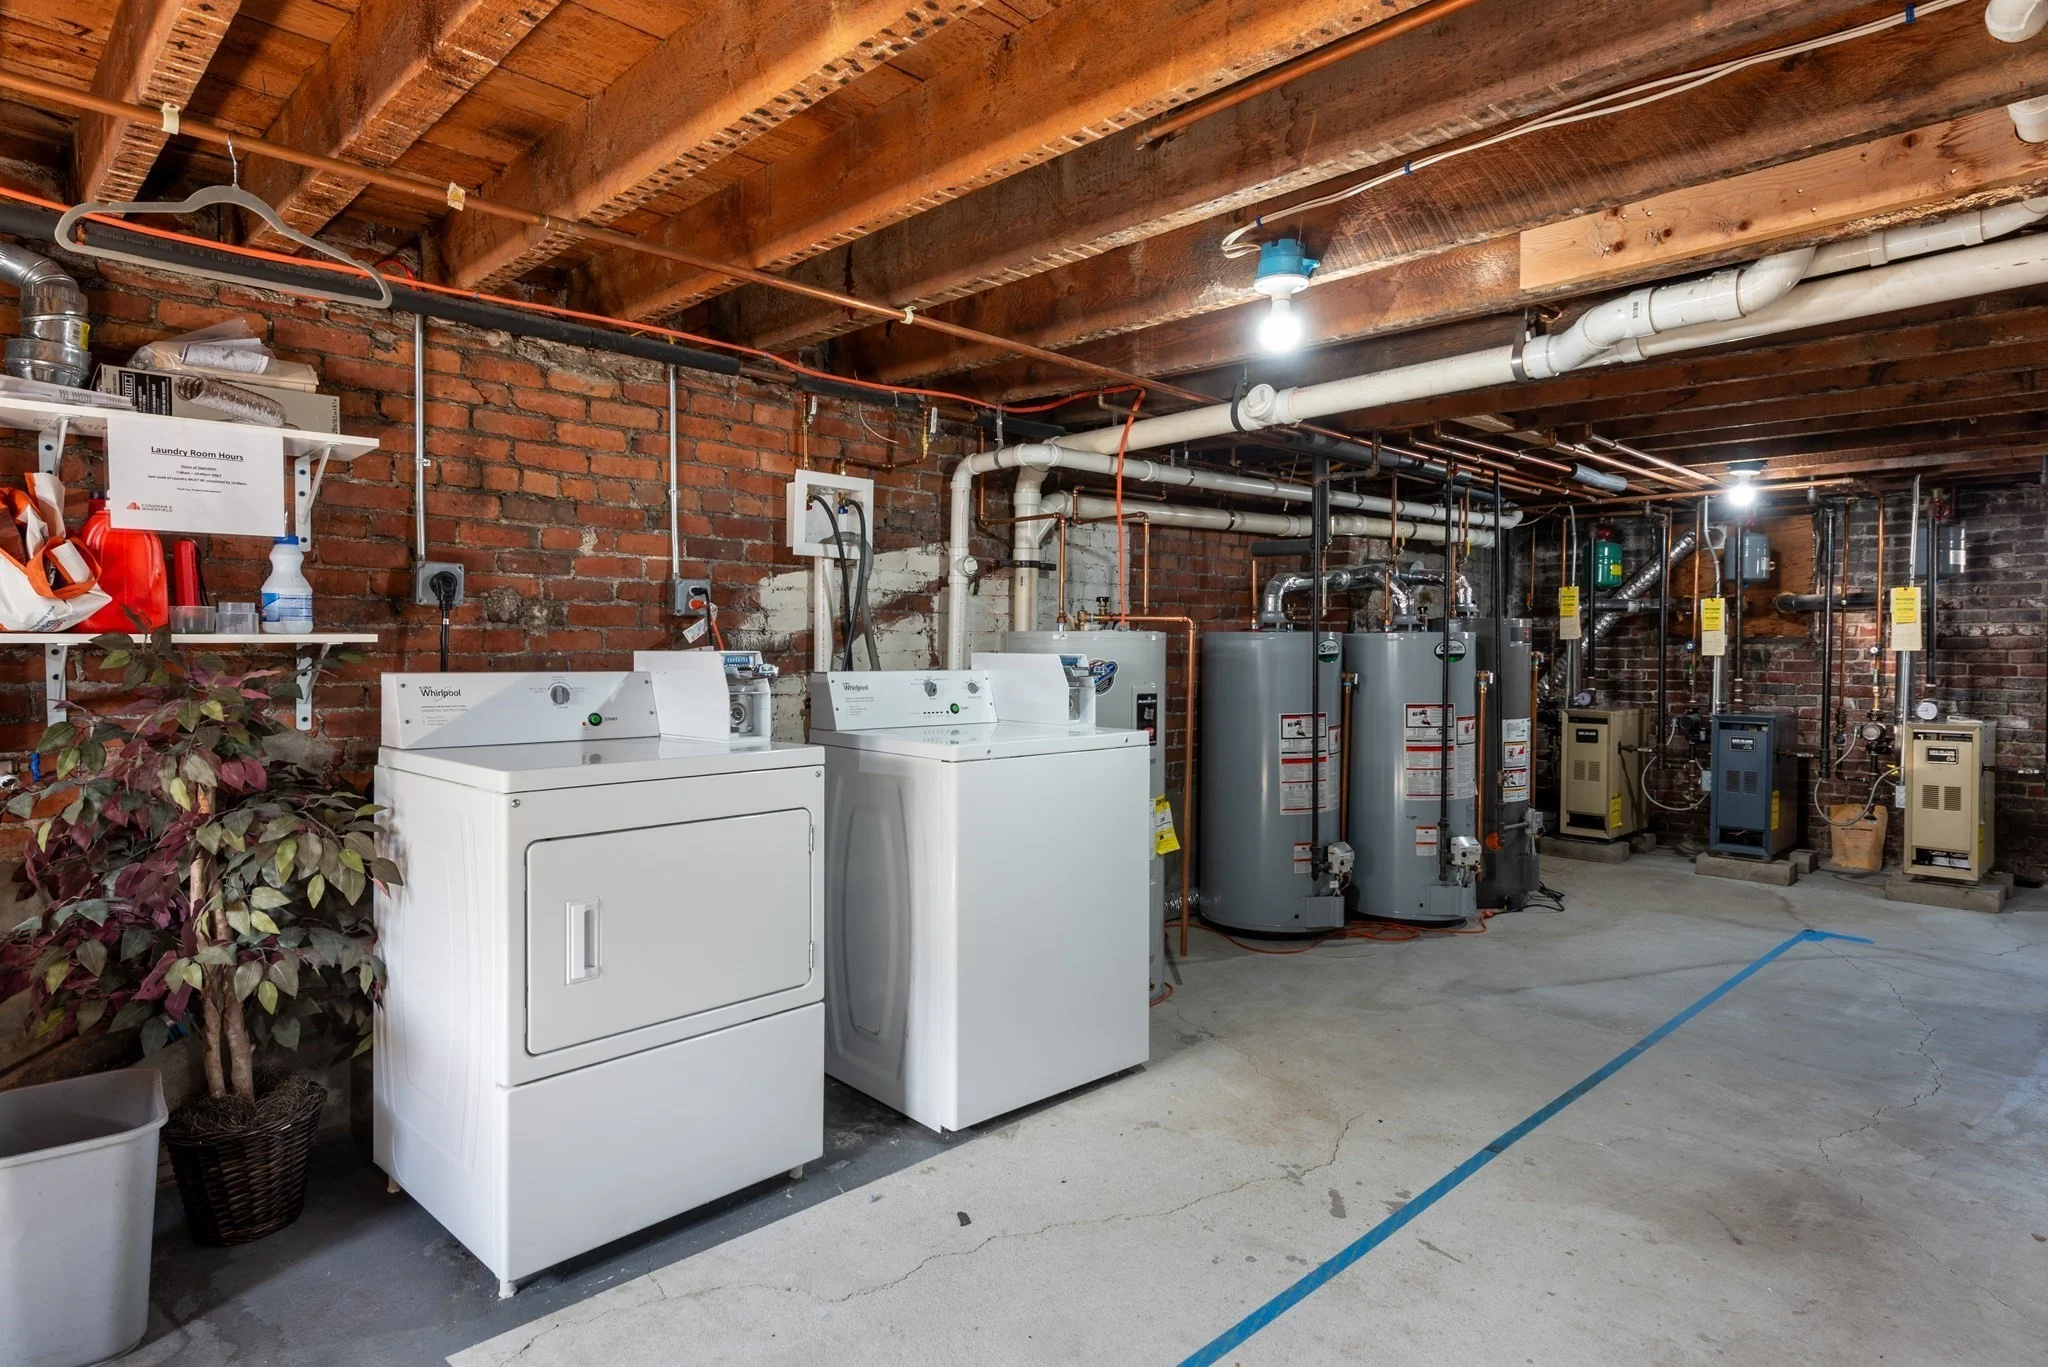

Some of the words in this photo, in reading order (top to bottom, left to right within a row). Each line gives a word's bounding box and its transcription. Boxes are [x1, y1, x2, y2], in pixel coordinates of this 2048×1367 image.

[151, 446, 188, 457] Laundry
[190, 449, 216, 458] Room
[219, 452, 244, 461] Hours
[844, 684, 869, 692] Whirlpool
[420, 689, 461, 699] Whirlpool
